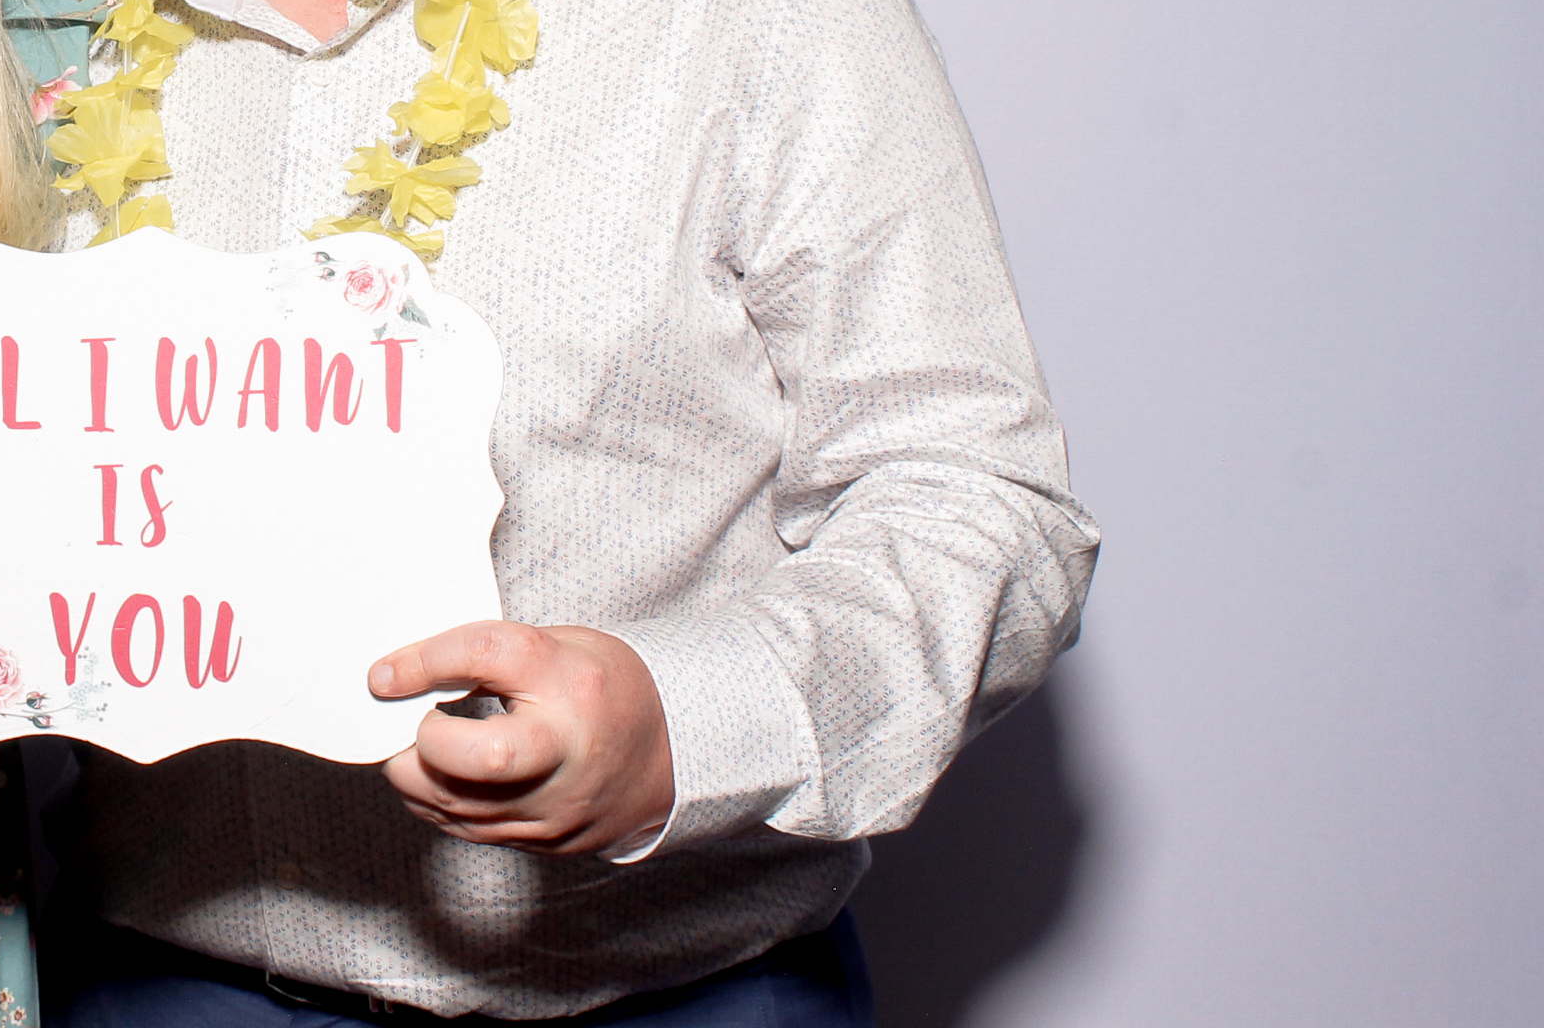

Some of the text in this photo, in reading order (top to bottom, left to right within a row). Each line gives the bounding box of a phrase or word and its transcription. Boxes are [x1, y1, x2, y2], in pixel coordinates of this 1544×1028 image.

[80, 336, 117, 434] I
[155, 336, 418, 435] WANT
[92, 463, 174, 549] IS
[48, 591, 243, 690] YOU
